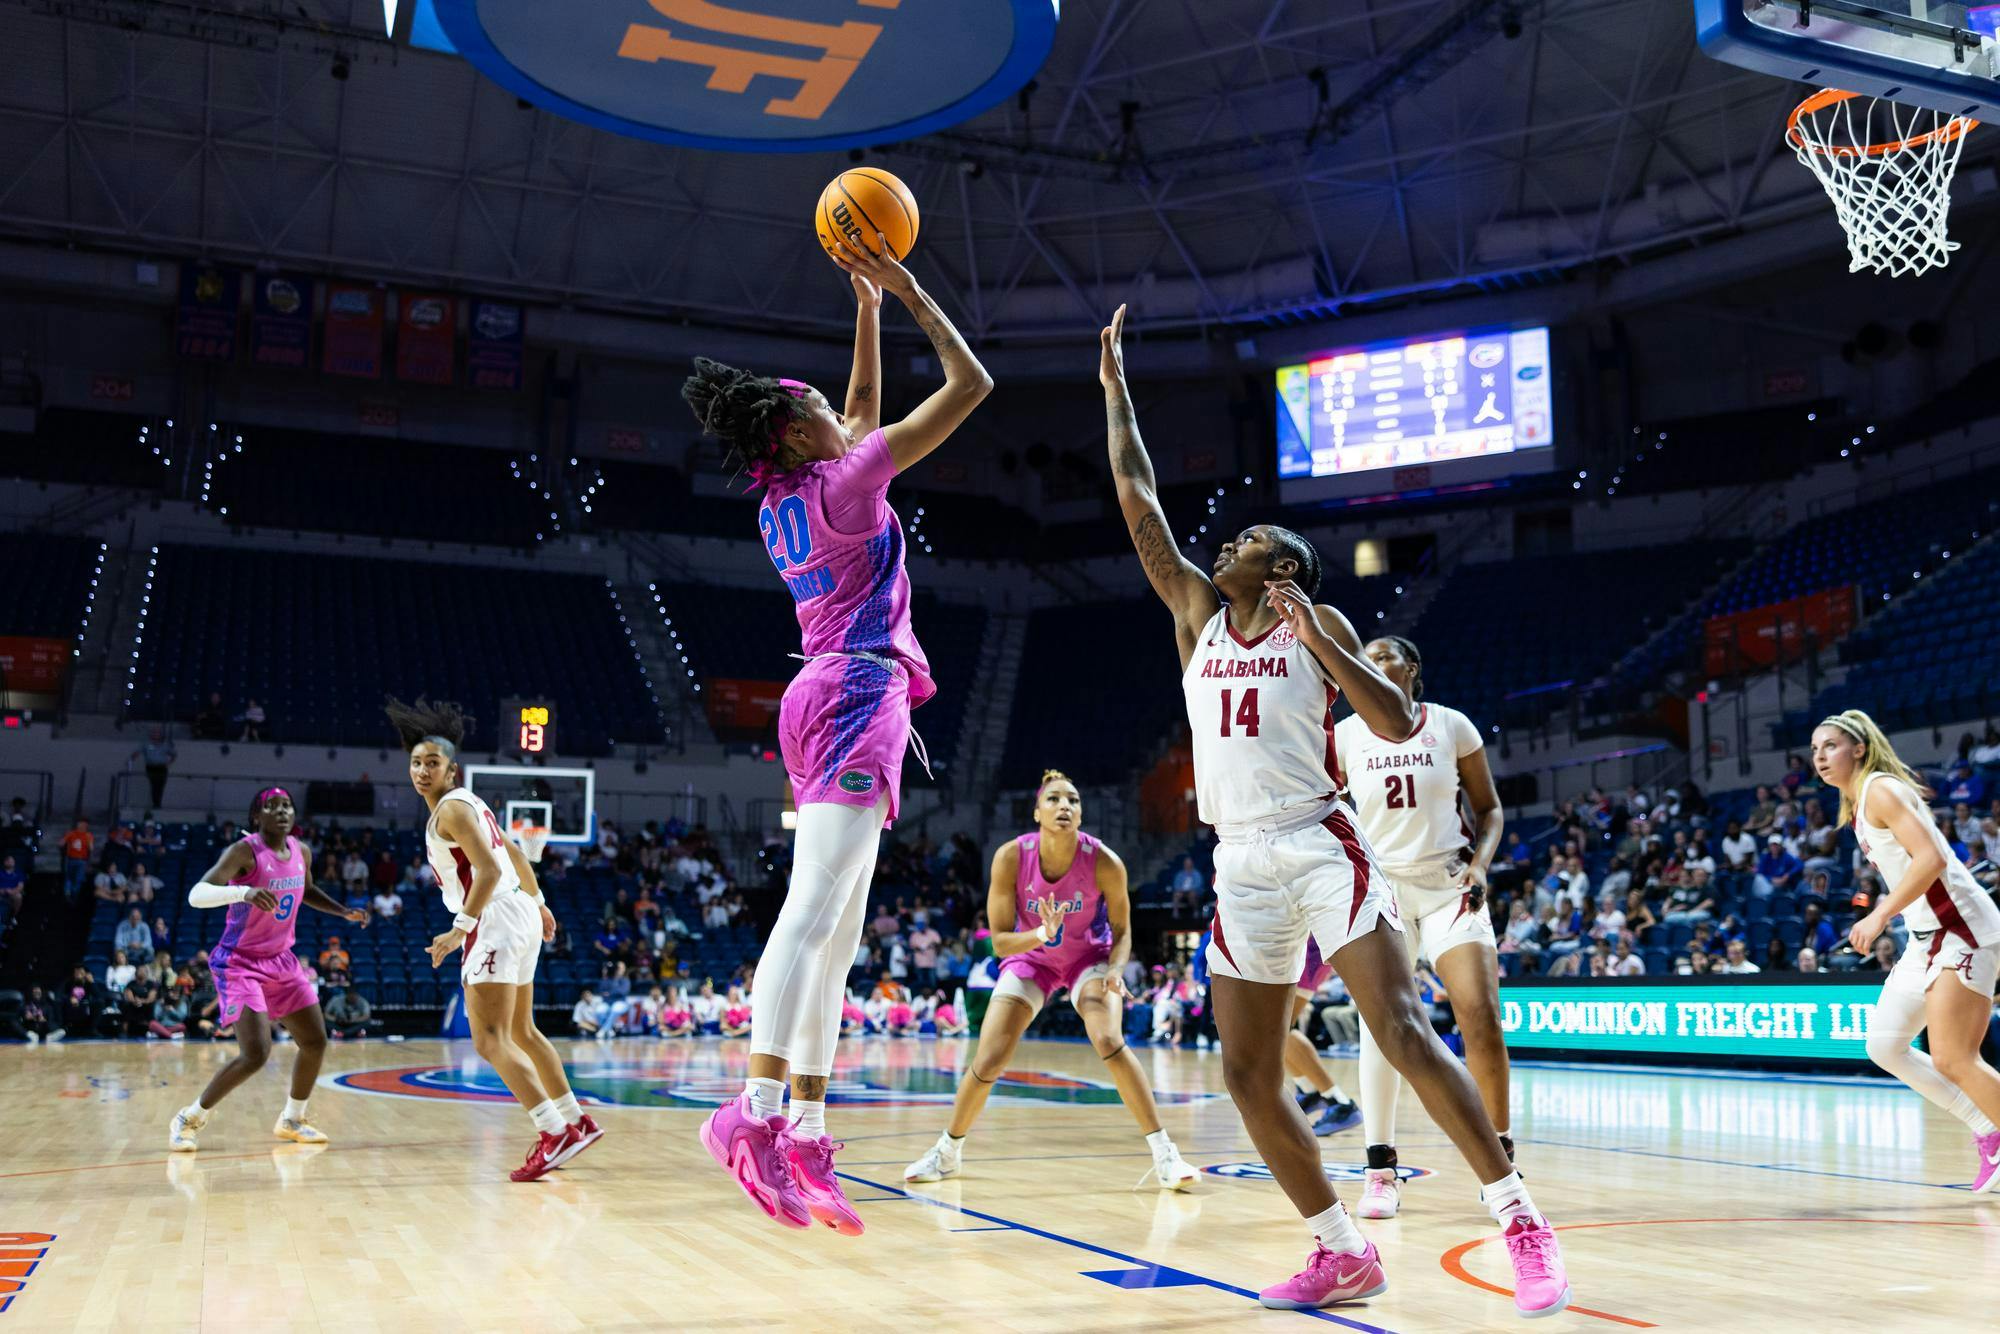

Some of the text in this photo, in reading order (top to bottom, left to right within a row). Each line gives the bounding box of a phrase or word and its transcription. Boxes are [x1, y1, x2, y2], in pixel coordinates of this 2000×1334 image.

[93, 380, 131, 397] 204
[759, 494, 812, 573] 20
[1201, 657, 1288, 678] ALABAMA
[1220, 688, 1260, 737] 14
[521, 725, 544, 751] 13
[1366, 753, 1434, 771] ALABAMA
[1385, 774, 1417, 809] 21
[275, 894, 295, 921] 9
[473, 950, 497, 976] A
[1956, 952, 1974, 981] A
[1528, 1001, 1668, 1036] DOMINION
[1675, 1002, 1818, 1040] FREIGHT
